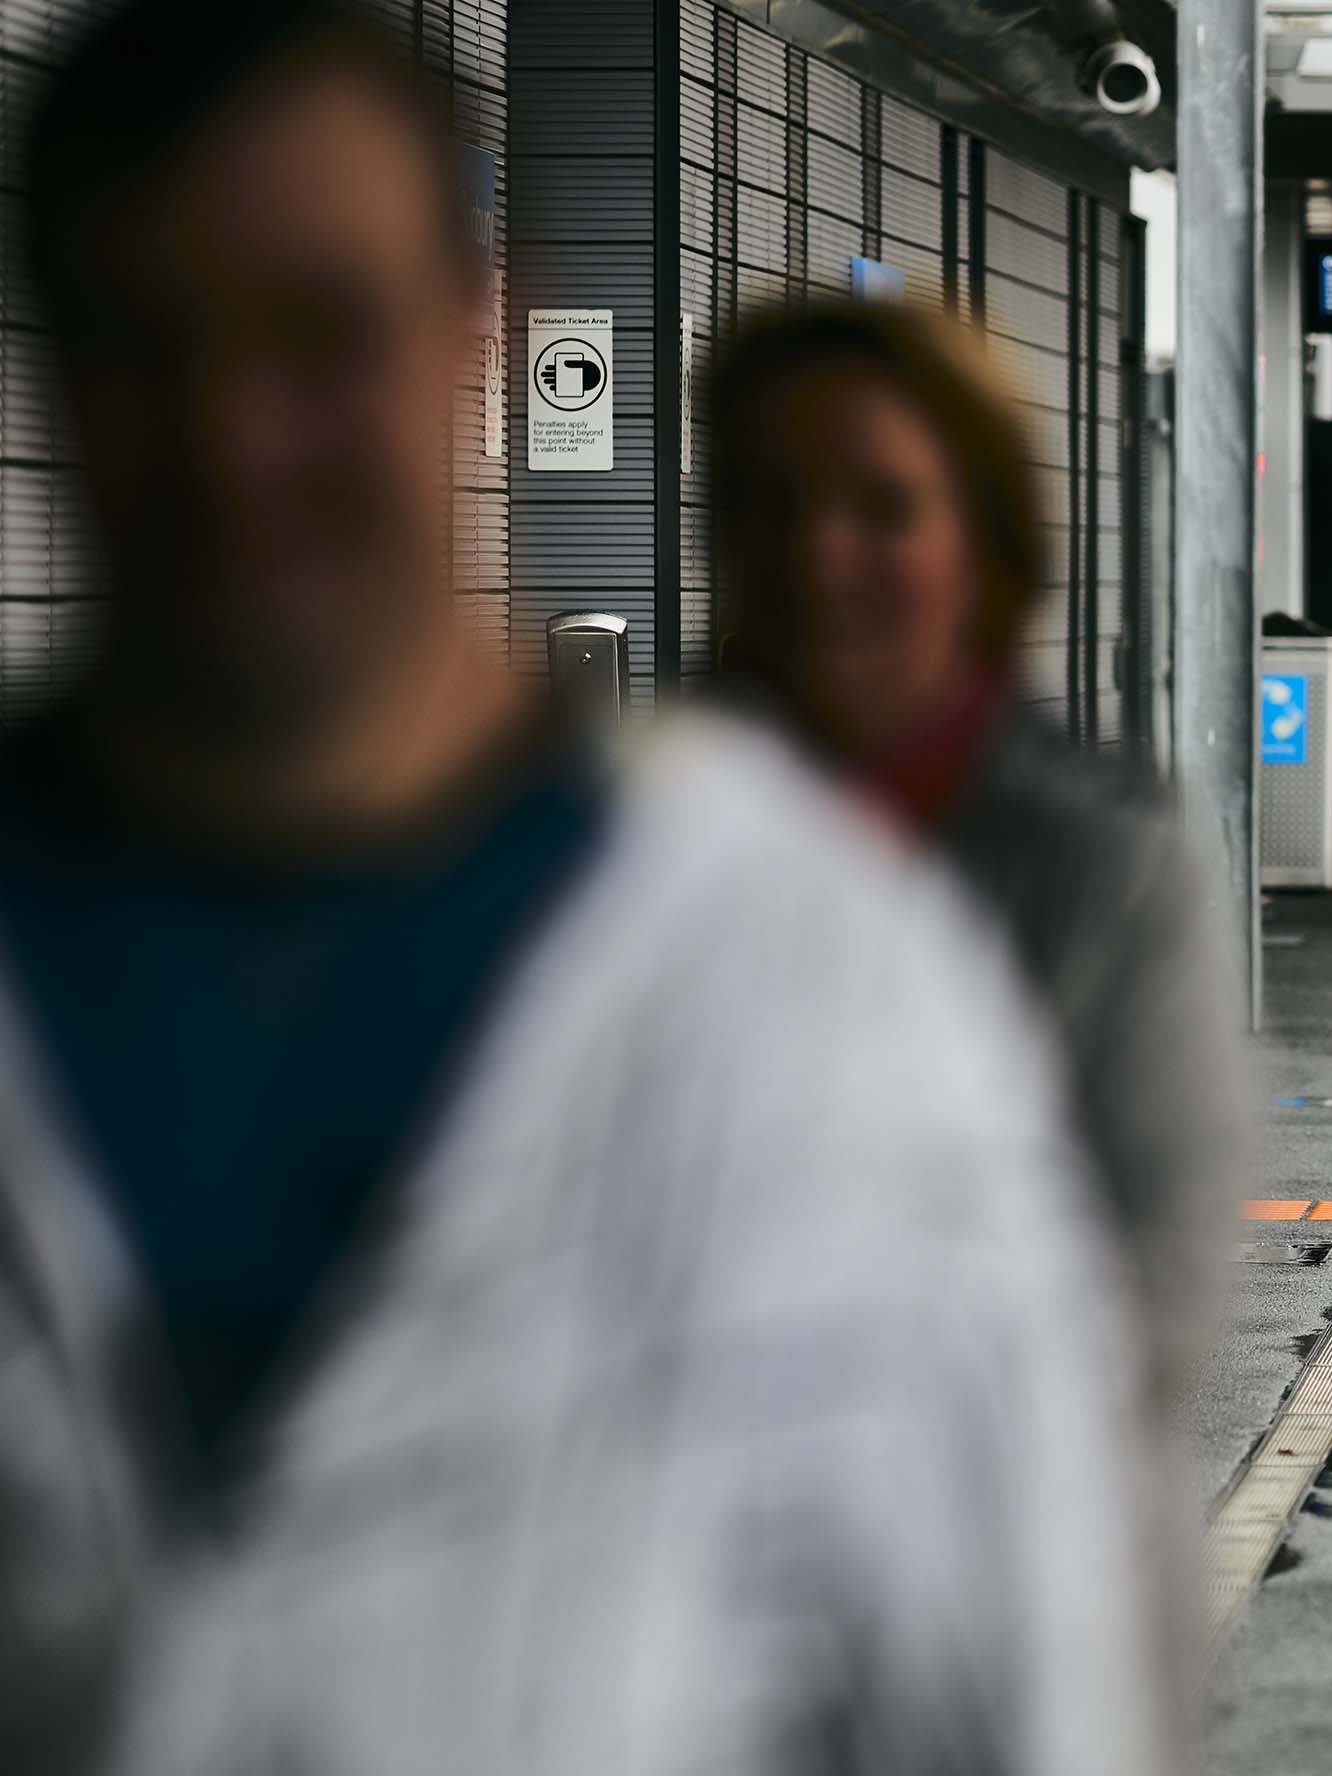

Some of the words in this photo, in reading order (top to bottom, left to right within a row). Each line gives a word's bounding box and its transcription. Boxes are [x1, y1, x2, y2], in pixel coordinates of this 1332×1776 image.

[533, 317, 566, 325] Validated
[568, 317, 590, 325] Ticket
[591, 317, 609, 325] Area
[533, 420, 566, 428] Penalties
[568, 420, 589, 430] apply
[533, 428, 544, 436] for
[545, 429, 575, 438] entering
[576, 428, 604, 438] beyond
[533, 437, 547, 445] this
[548, 437, 567, 447] point
[569, 437, 595, 445] without
[540, 445, 557, 453] valid
[558, 445, 579, 453] ticket
